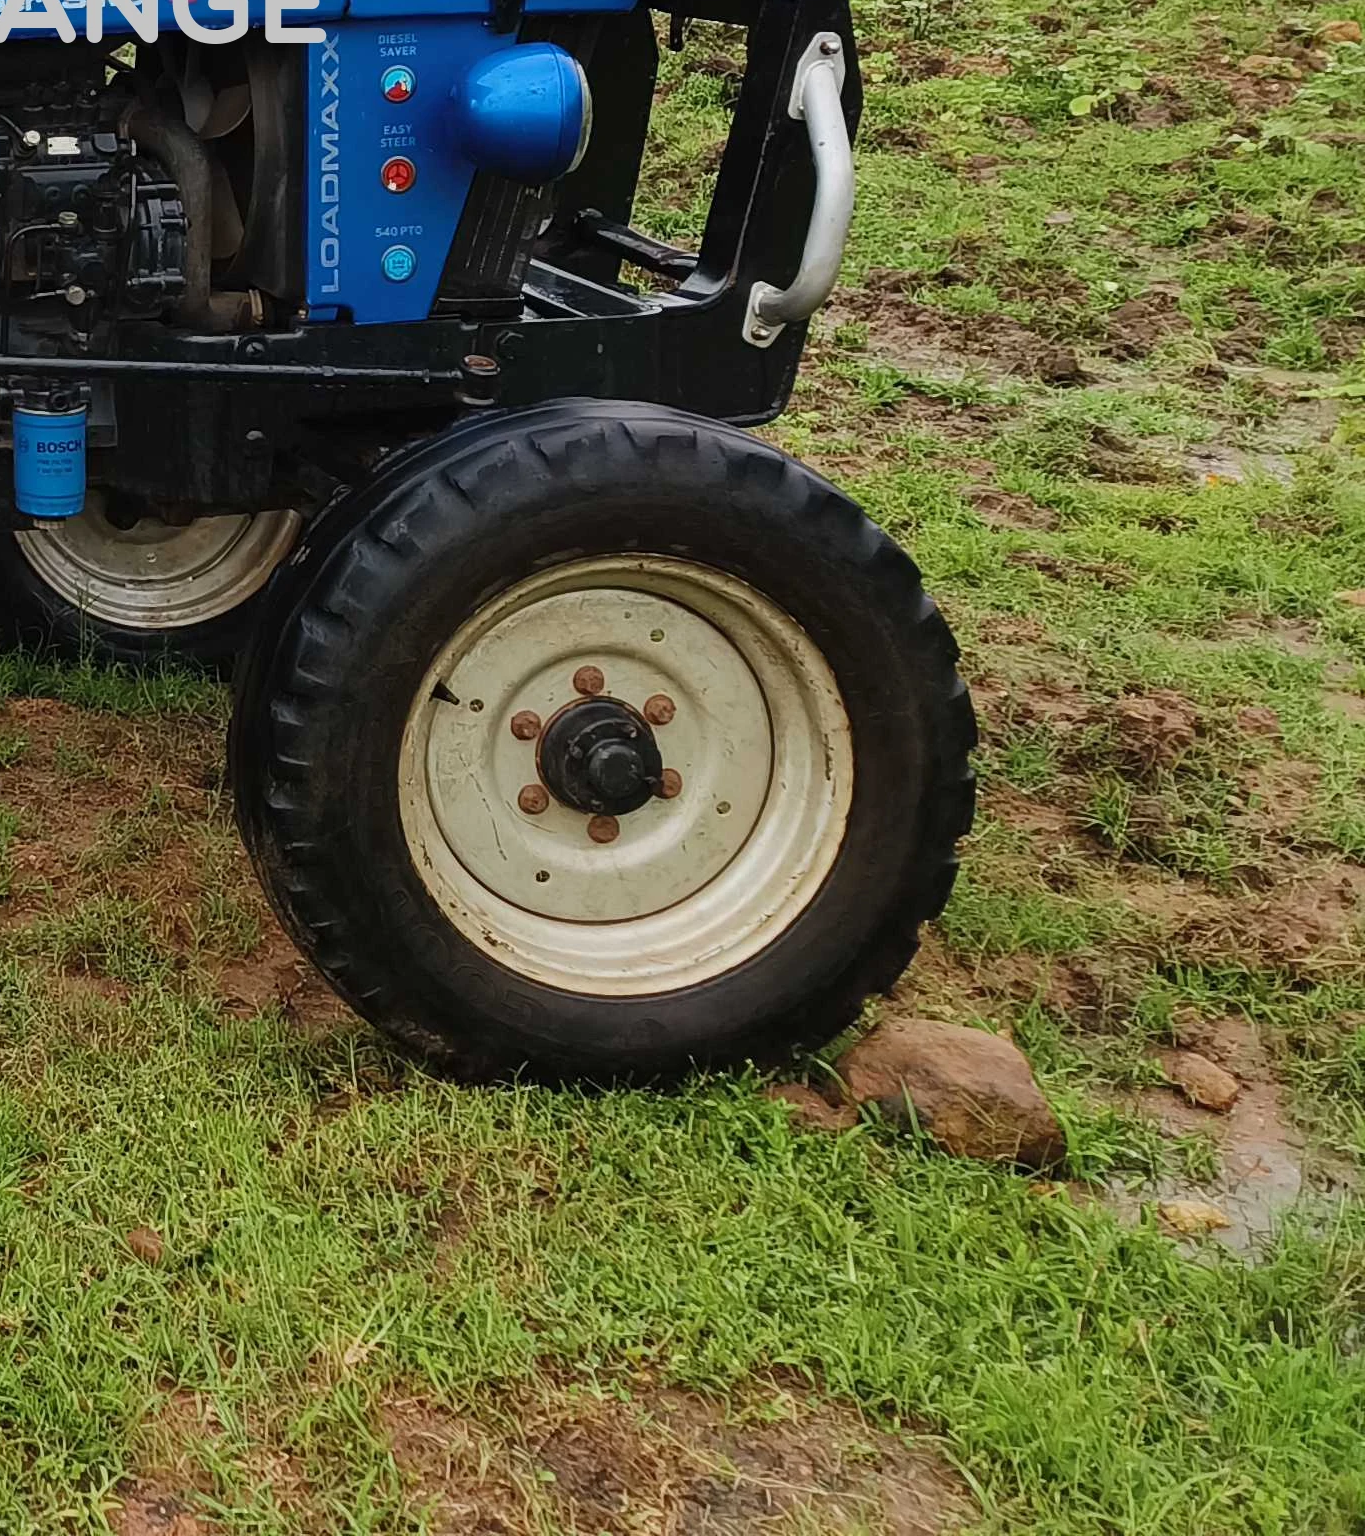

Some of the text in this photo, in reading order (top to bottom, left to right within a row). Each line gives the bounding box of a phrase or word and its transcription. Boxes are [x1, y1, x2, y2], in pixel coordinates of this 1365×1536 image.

[378, 33, 418, 44] DIESEL
[380, 45, 417, 57] SAVER
[383, 124, 413, 135] EASY
[380, 136, 416, 148] STEER
[320, 32, 341, 294] LOADMAXX
[375, 225, 423, 238] 540 PTO
[36, 439, 82, 454] BOSCH
